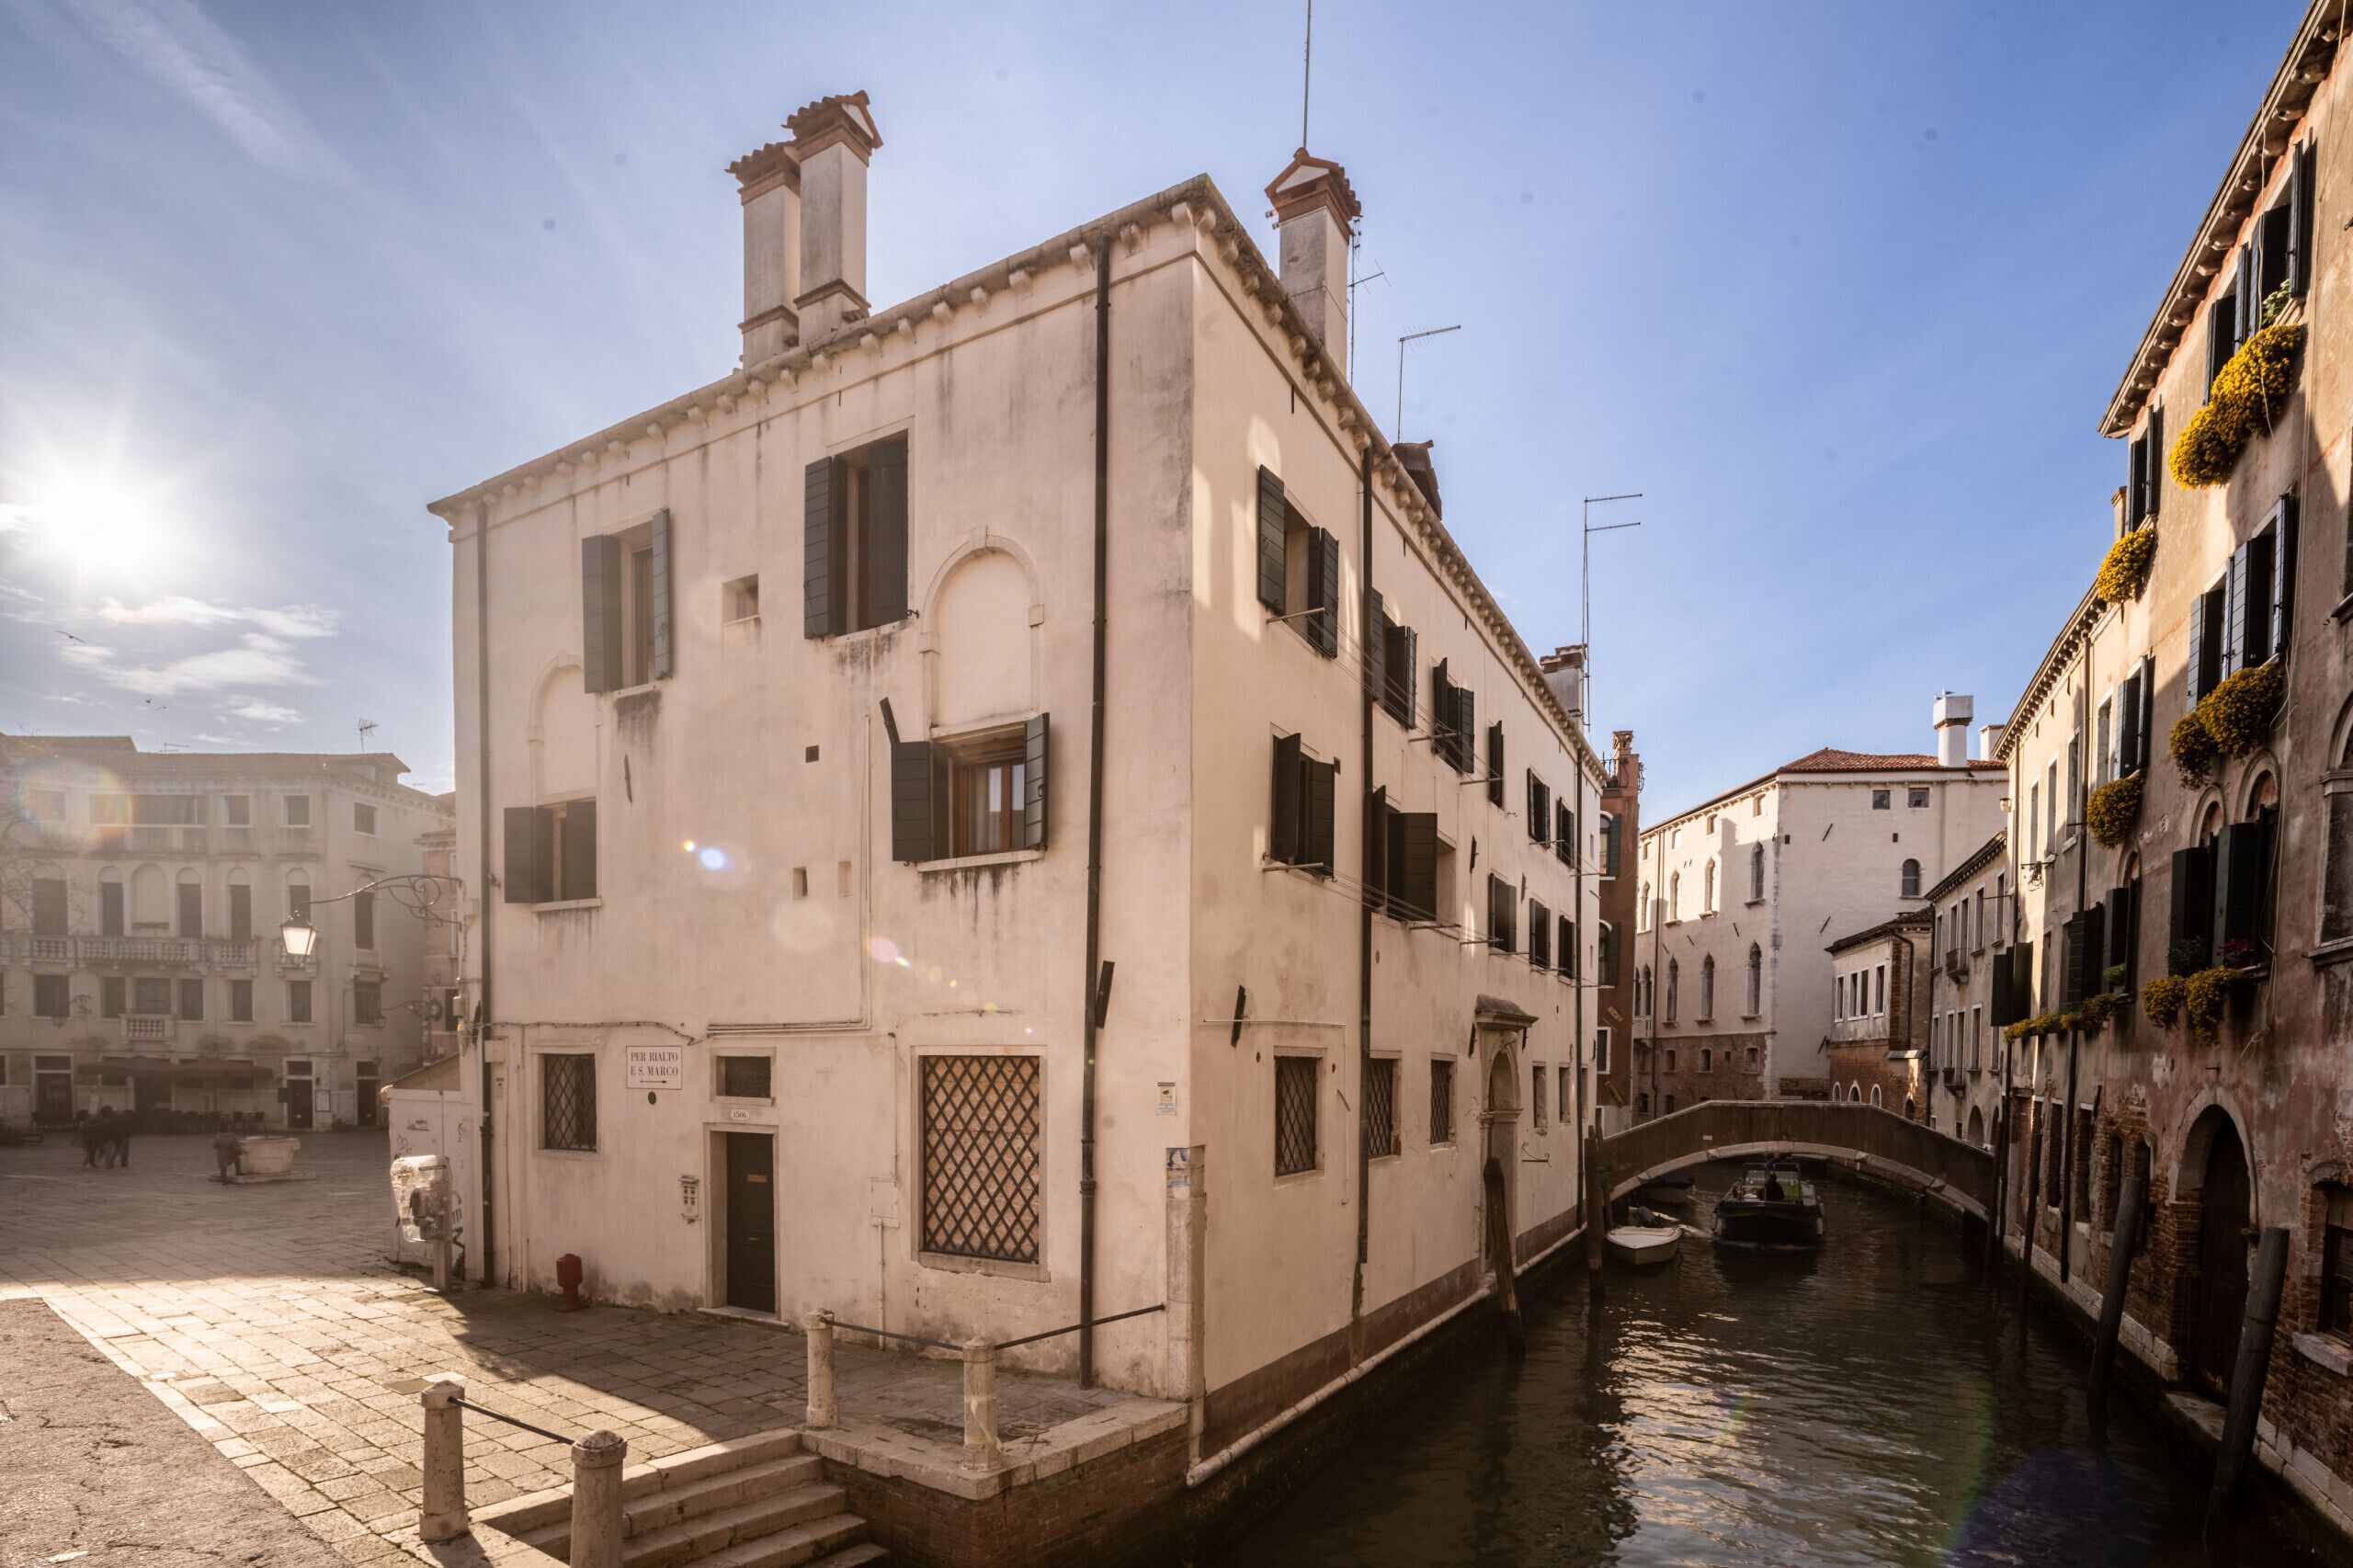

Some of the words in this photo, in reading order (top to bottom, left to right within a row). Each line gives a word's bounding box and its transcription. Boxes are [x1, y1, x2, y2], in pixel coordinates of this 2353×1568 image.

[631, 1051, 646, 1062] PER
[649, 1051, 678, 1062] RIALTO
[631, 1066, 636, 1075] E
[638, 1066, 645, 1075] S.
[647, 1066, 678, 1075] MARCO
